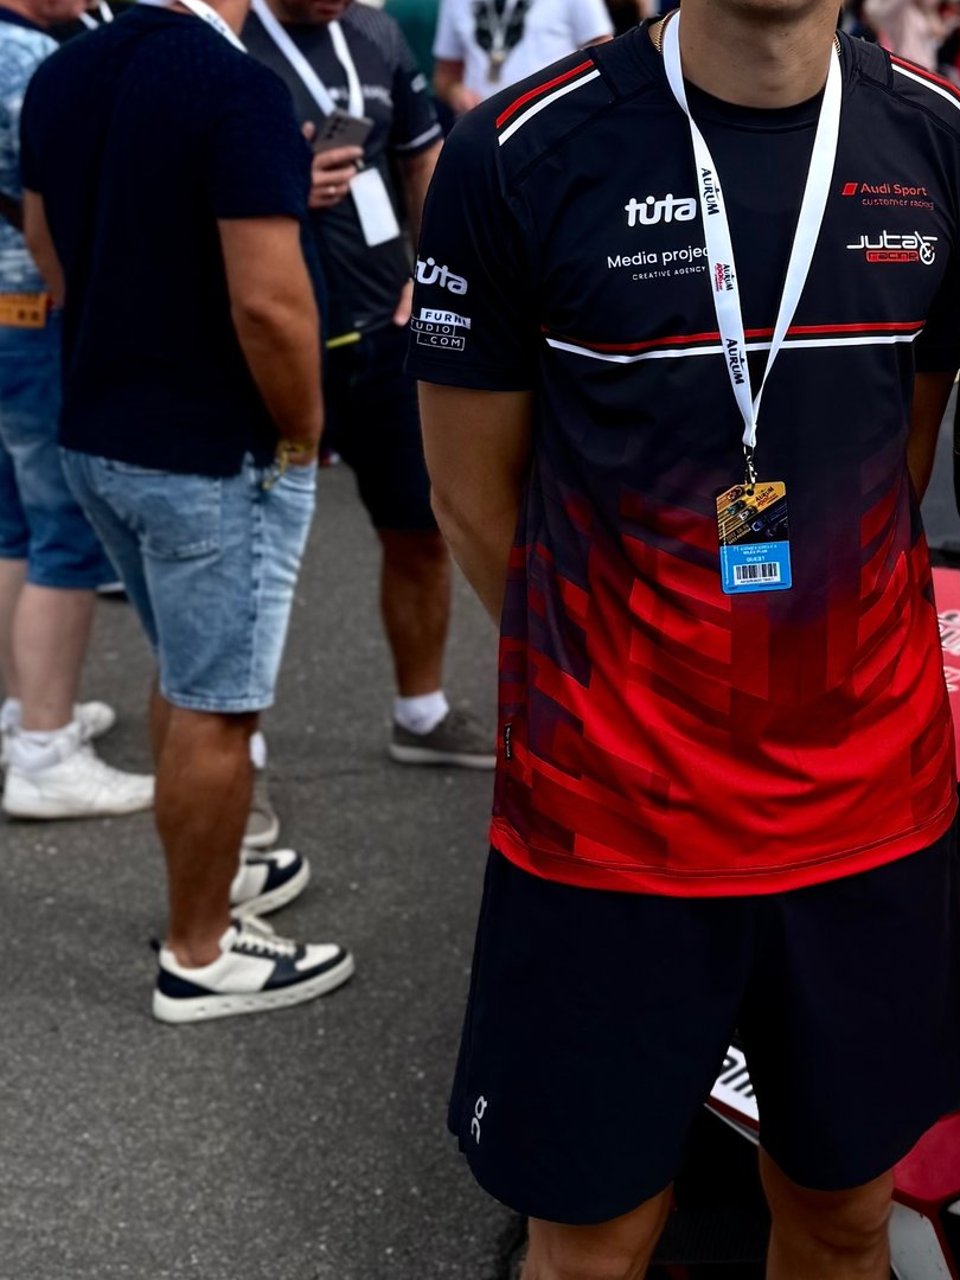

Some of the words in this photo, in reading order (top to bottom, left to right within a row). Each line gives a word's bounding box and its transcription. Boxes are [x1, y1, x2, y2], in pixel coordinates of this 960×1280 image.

[701, 167, 719, 216] AURUM
[860, 183, 891, 194] Audi
[893, 184, 928, 197] Sport
[607, 251, 658, 269] Media
[662, 245, 709, 266] projec
[632, 270, 671, 281] CREATIVE
[674, 266, 706, 276] AGENCY
[726, 338, 745, 385] AURUM
